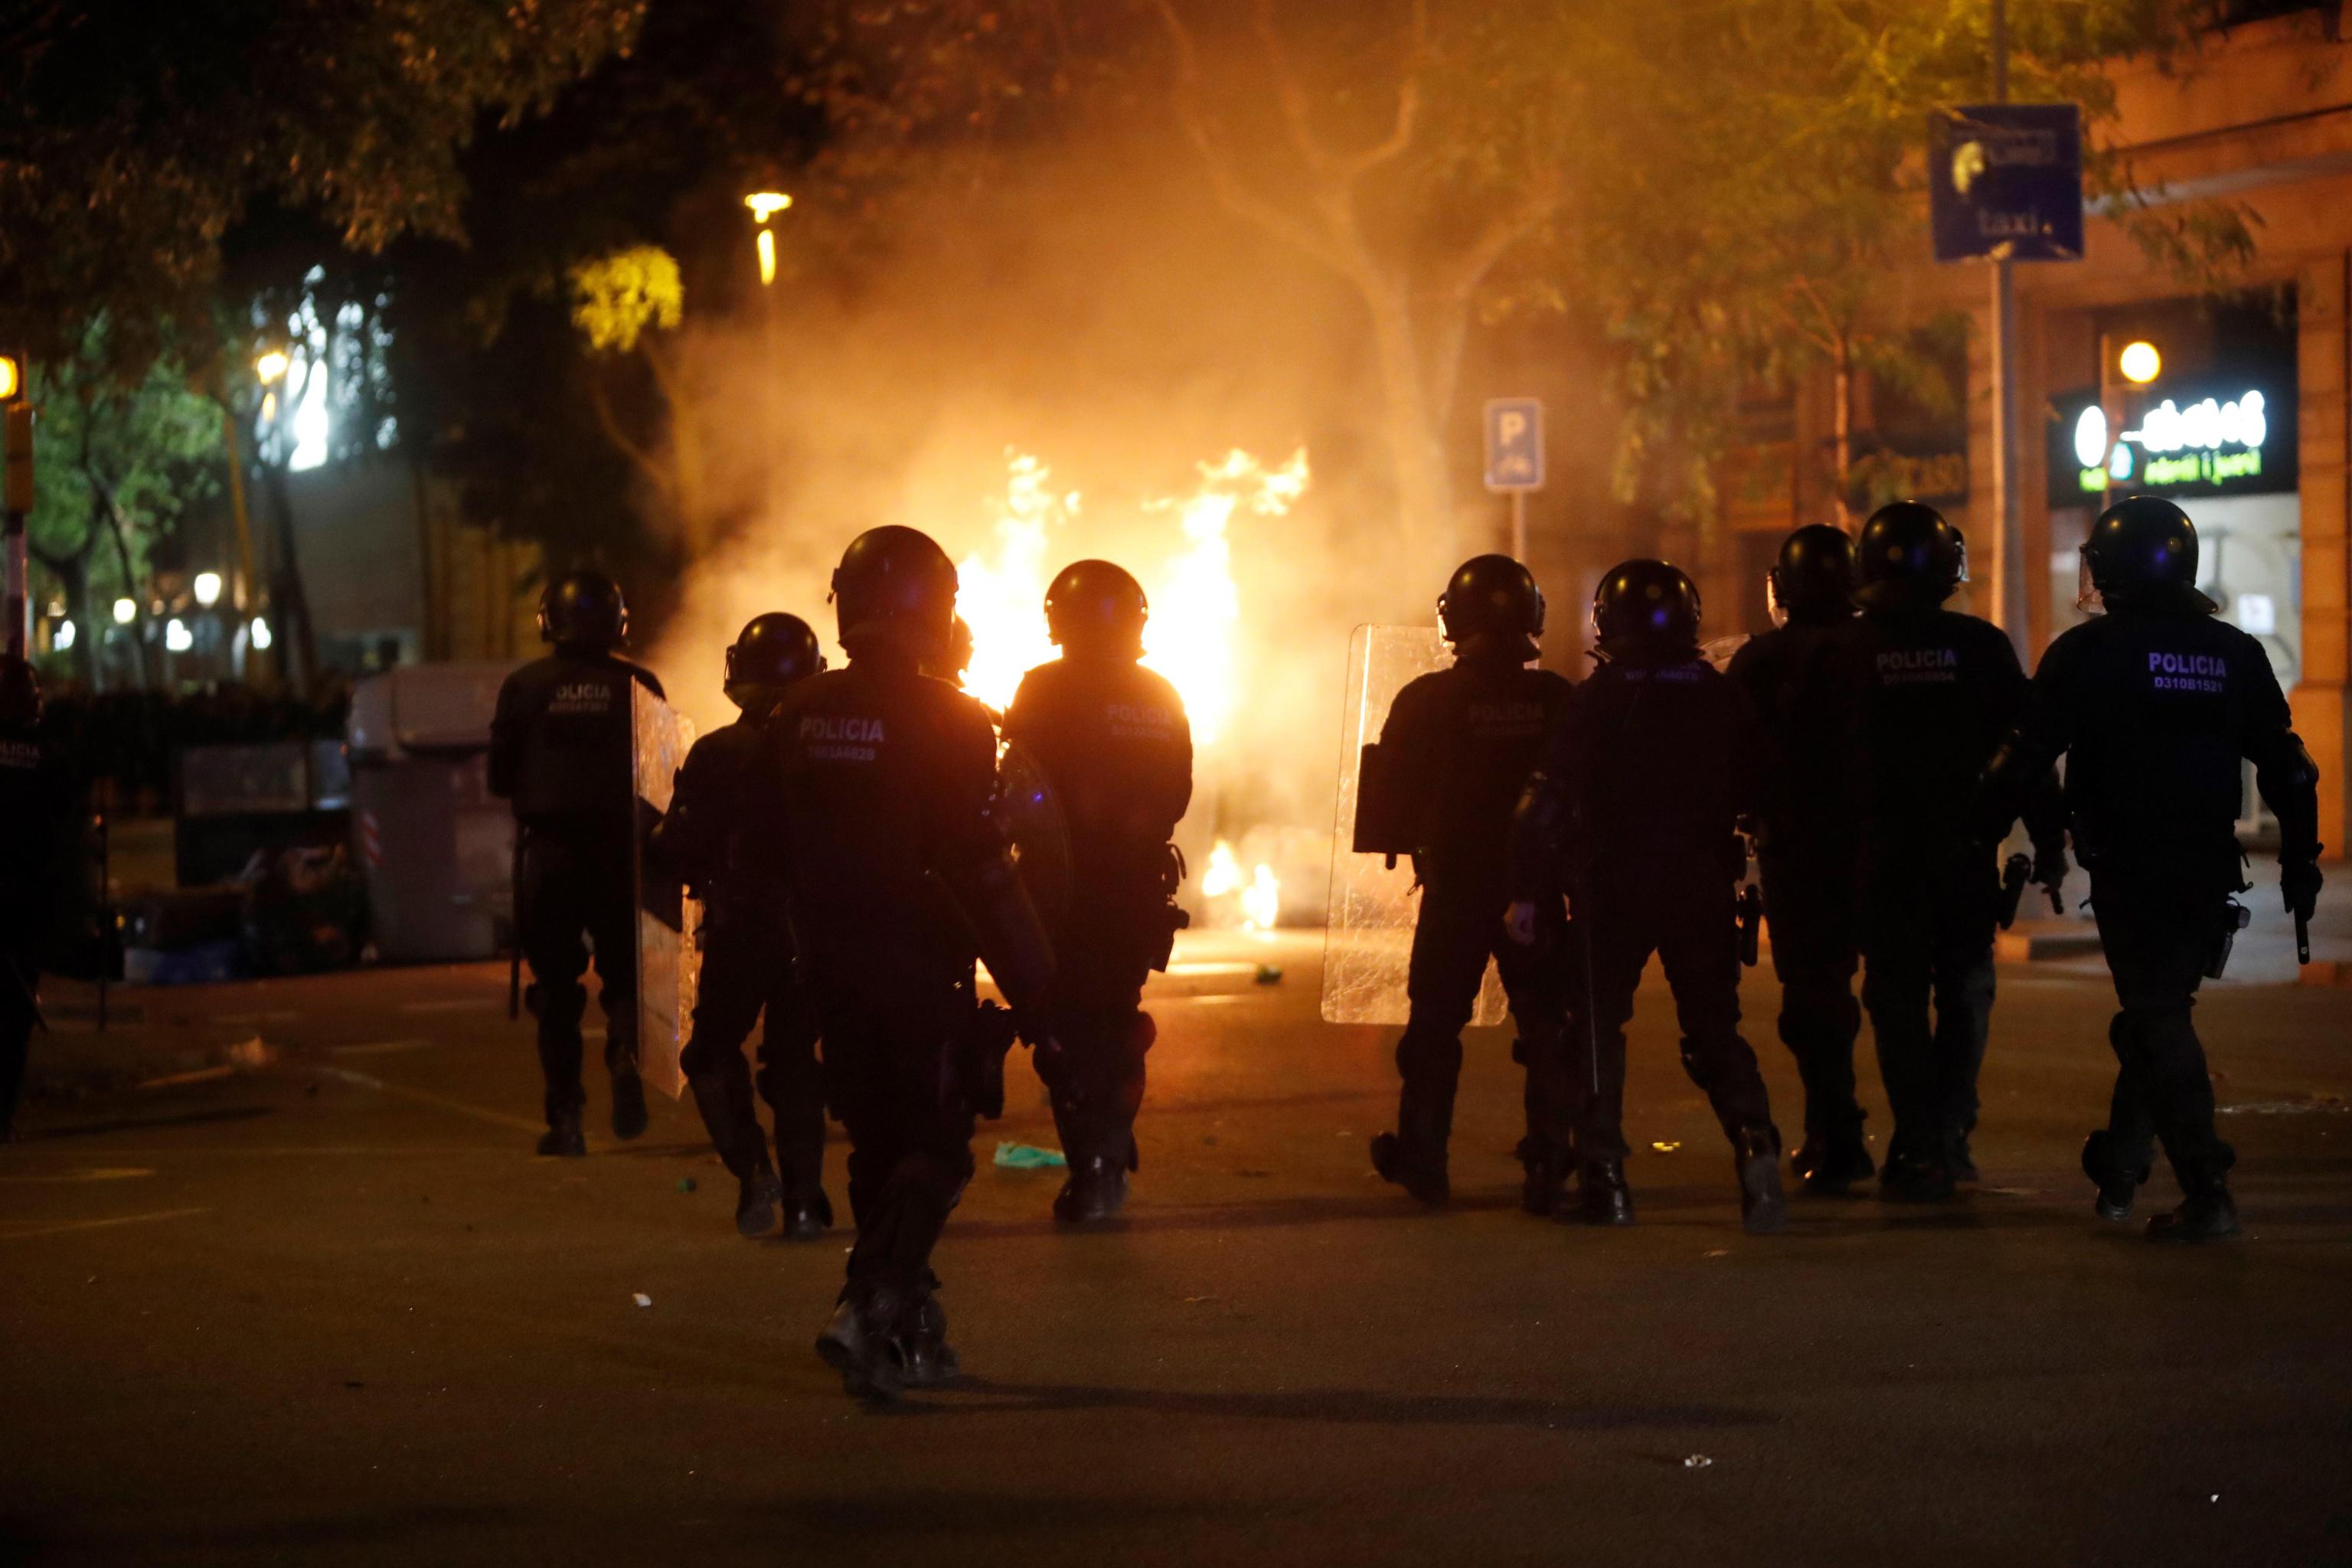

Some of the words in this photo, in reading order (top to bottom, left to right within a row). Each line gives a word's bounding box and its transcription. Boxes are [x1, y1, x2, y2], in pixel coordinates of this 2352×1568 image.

[1977, 207, 2038, 237] taxi
[1501, 413, 1525, 445] P
[1877, 648, 1958, 671] POLICIA
[2148, 652, 2227, 678] POLICIA
[555, 684, 612, 701] OLICIA
[2154, 676, 2223, 693] D310B1521
[800, 717, 884, 743] POLICIA
[0, 740, 41, 760] LICIA
